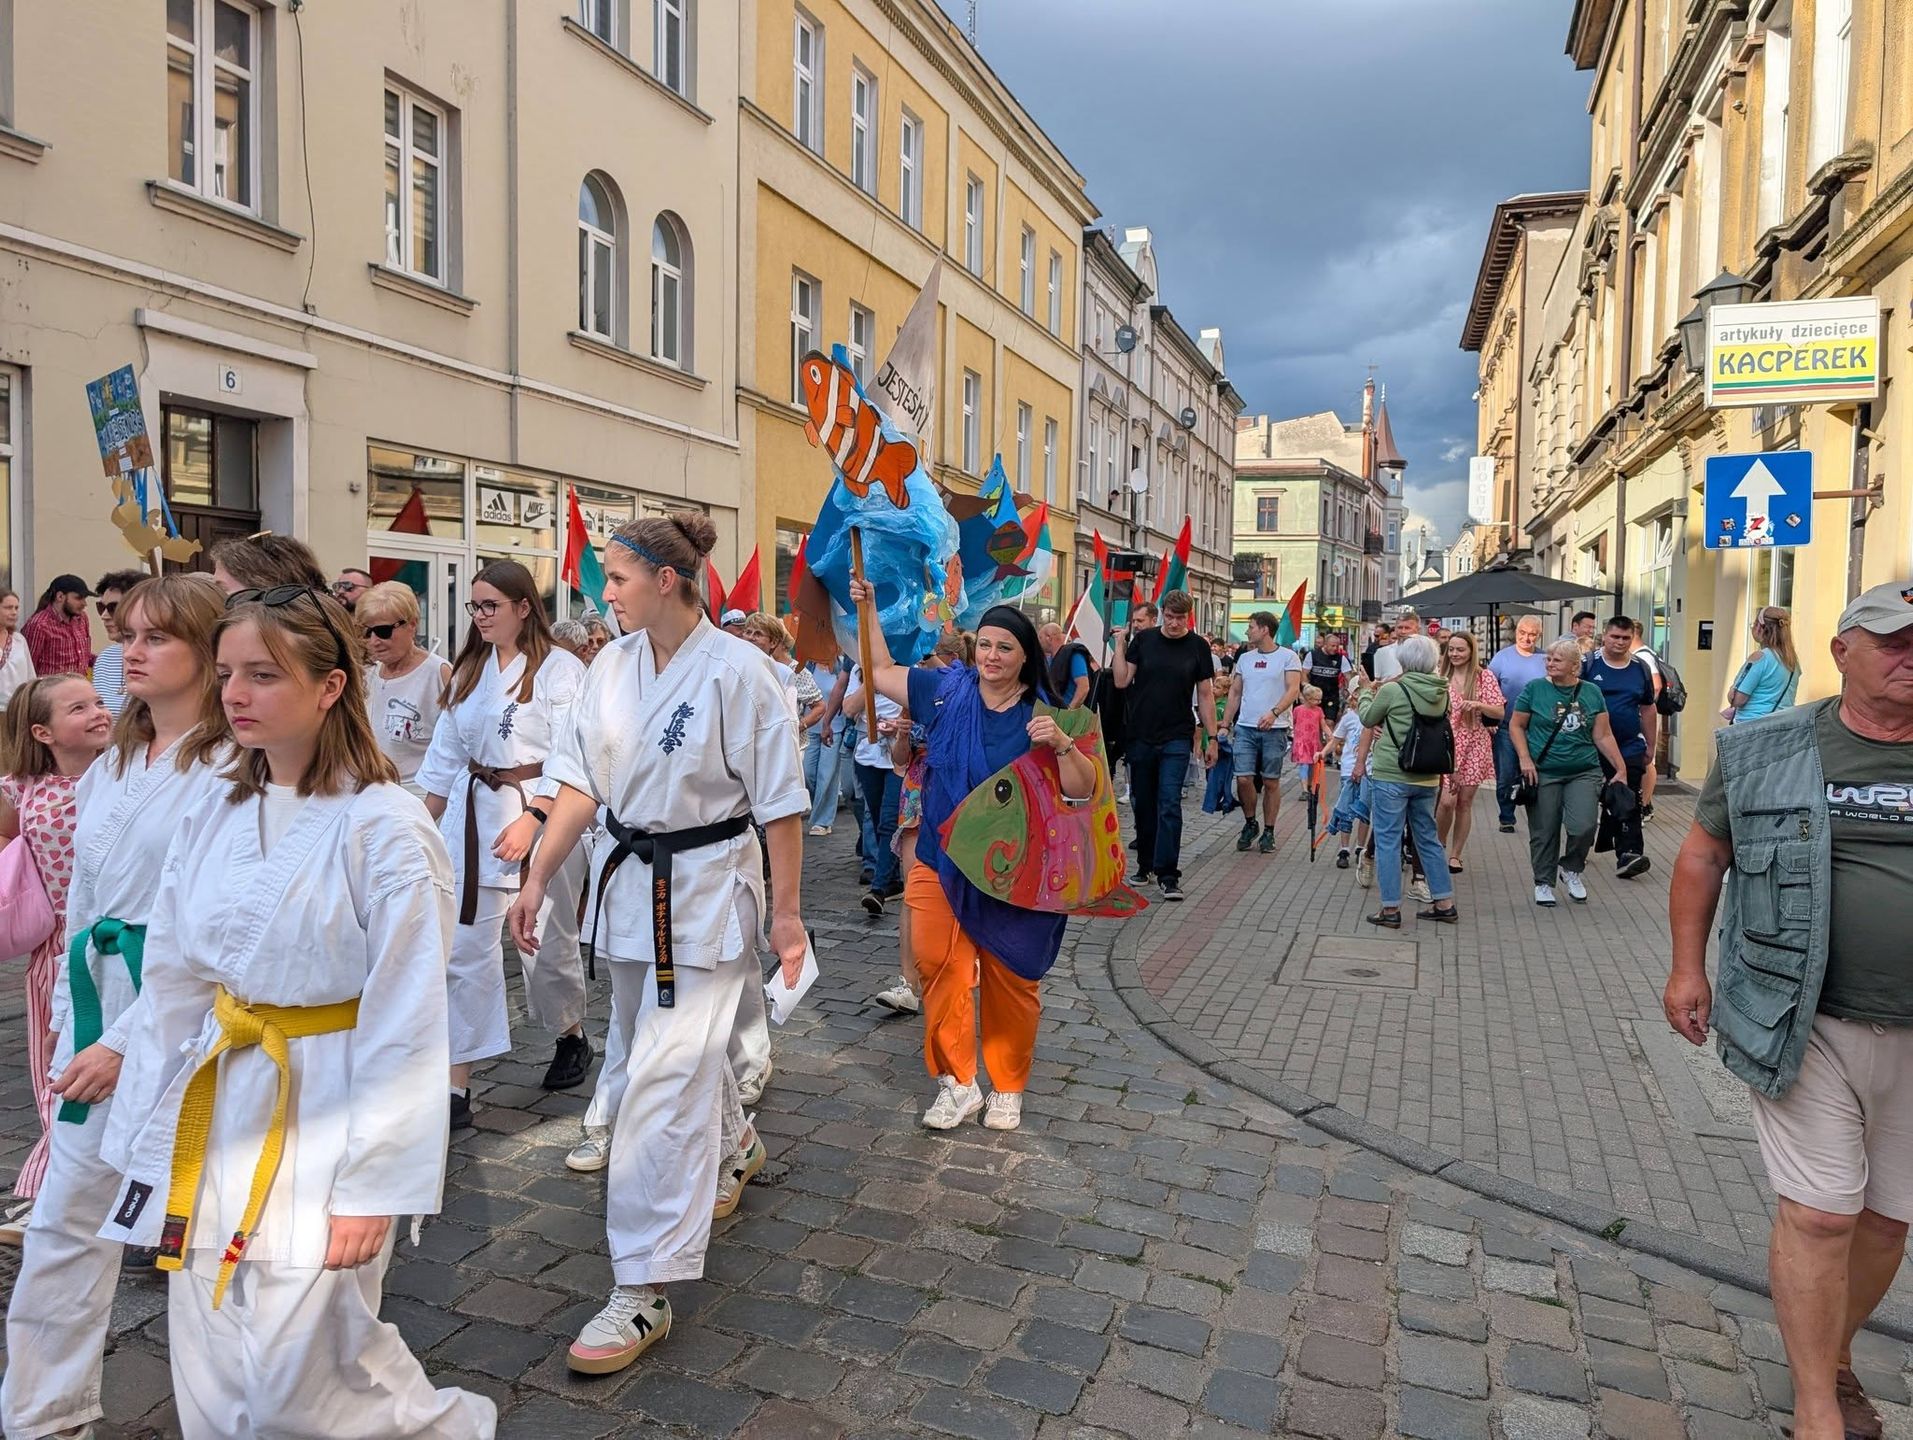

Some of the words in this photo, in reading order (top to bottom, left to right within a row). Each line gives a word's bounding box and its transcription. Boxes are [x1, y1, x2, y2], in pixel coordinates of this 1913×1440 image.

[1720, 326, 1783, 343] artykuły
[1791, 322, 1868, 338] dziecięce
[1719, 345, 1867, 375] KACPEREK
[225, 371, 236, 388] 6
[528, 501, 544, 514] NIKE
[484, 510, 512, 522] adidas
[1845, 811, 1900, 822] WORLD
